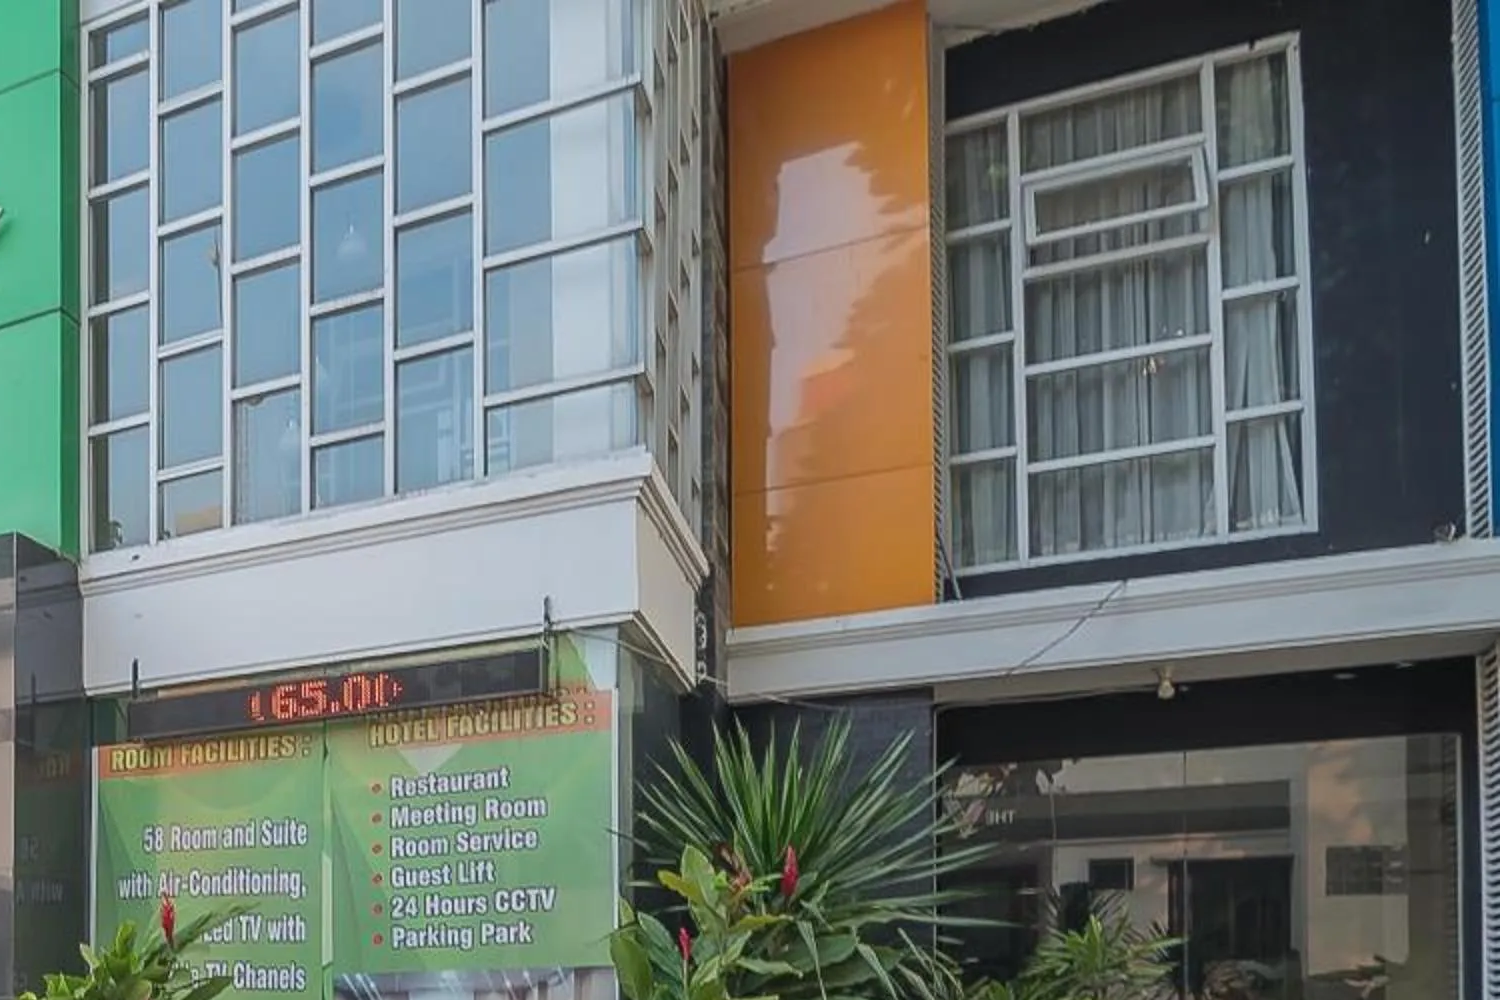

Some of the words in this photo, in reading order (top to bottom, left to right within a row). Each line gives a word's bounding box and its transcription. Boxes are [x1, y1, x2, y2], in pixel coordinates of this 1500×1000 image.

[370, 717, 439, 747] HOTEL
[447, 702, 578, 738] FACILITIES
[111, 747, 173, 771] ROOM
[181, 735, 296, 765] FACILITIES
[390, 767, 510, 798] Restaurant
[390, 803, 477, 829] Meeting
[485, 798, 548, 821] Room
[143, 825, 164, 852] 58
[171, 825, 217, 852] Room
[222, 821, 255, 847] and
[261, 818, 308, 847] Suite
[390, 835, 449, 859] Room
[456, 828, 538, 853] Service
[118, 872, 152, 898] with
[391, 864, 452, 887] Guest
[458, 860, 496, 884] Lift
[391, 895, 418, 919] 24
[425, 891, 488, 917] Hours
[494, 887, 556, 914] CCTV
[240, 914, 261, 941] TV
[267, 913, 305, 941] with
[391, 922, 475, 949] Parking
[480, 919, 533, 945] Park
[233, 962, 306, 991] Chanels
